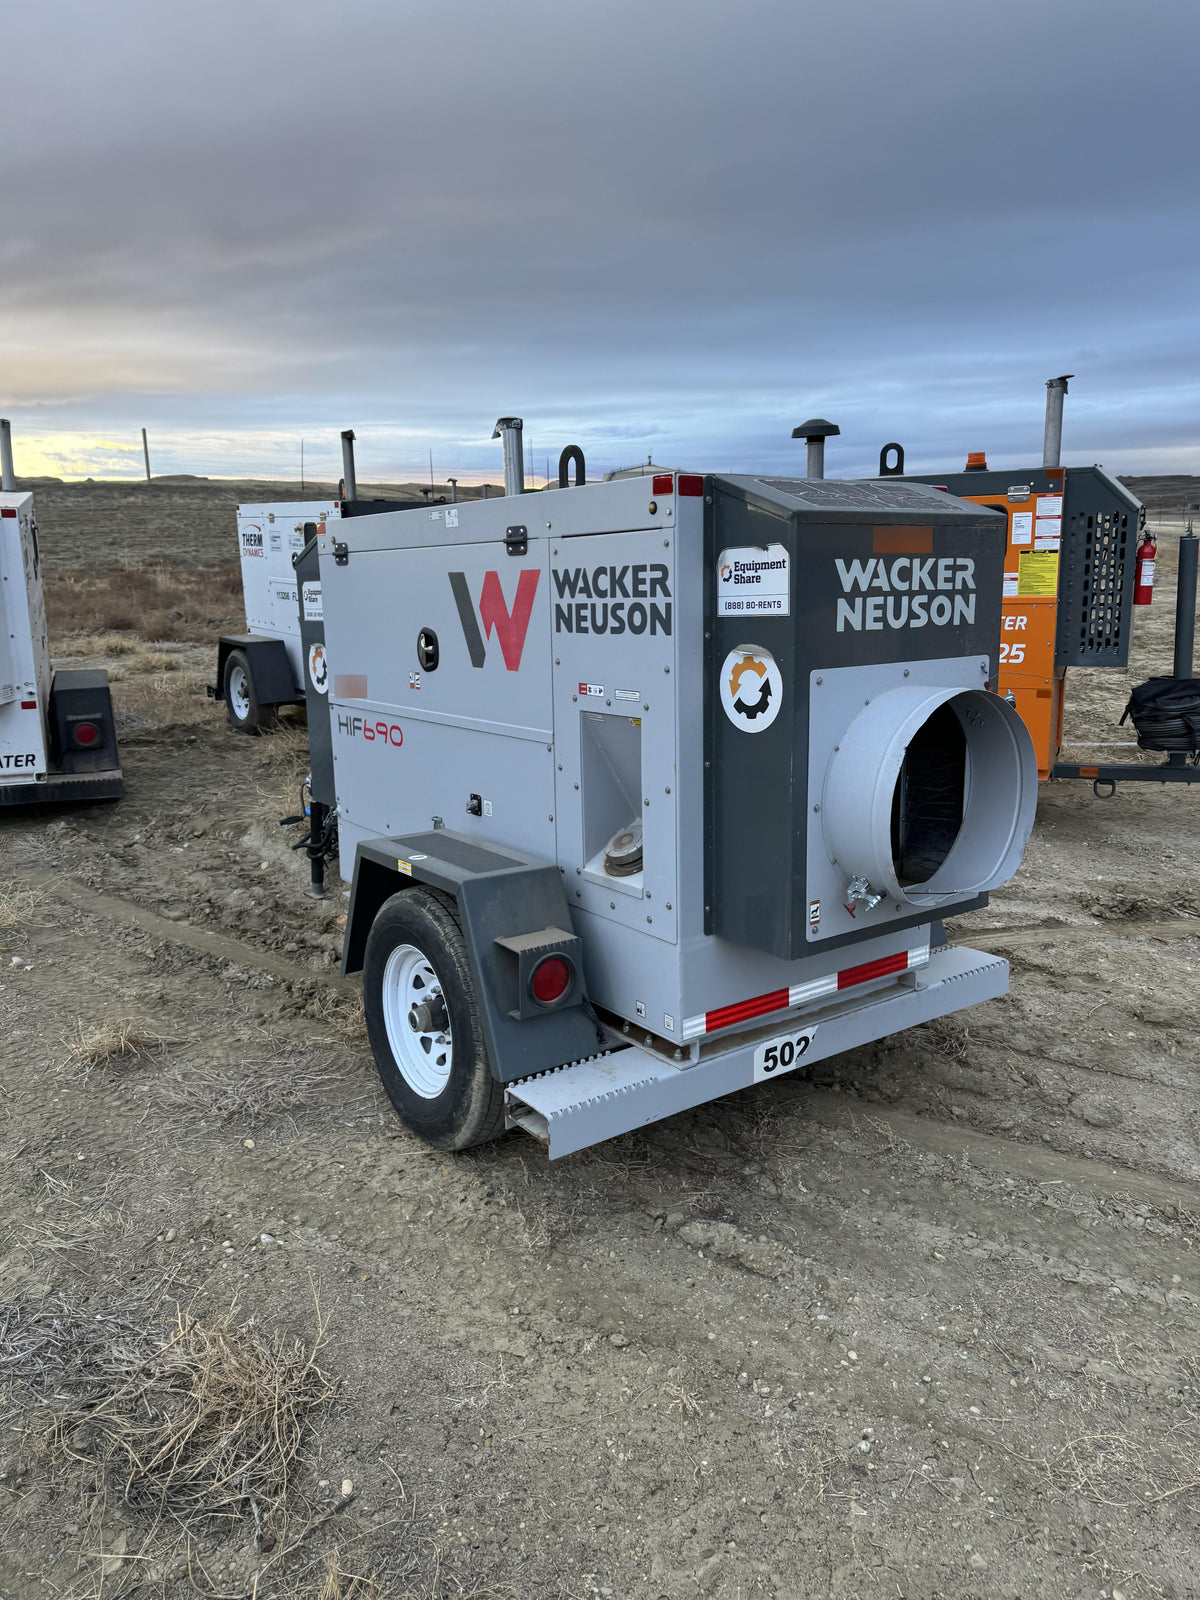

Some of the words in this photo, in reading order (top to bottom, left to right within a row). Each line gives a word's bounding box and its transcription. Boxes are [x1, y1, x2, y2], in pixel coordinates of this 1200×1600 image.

[242, 533, 264, 547] THERM
[242, 548, 264, 558] DYNAMICS
[552, 563, 672, 599] WACKER
[733, 574, 761, 584] Share
[734, 558, 786, 573] Equipment
[834, 557, 977, 593] WACKER
[555, 602, 672, 636] NEUSON
[725, 601, 744, 610] (888)
[746, 600, 782, 609] 80-RENTS
[836, 593, 977, 632] NEUSON
[338, 714, 403, 747] HIF690
[763, 1033, 816, 1073] 502
